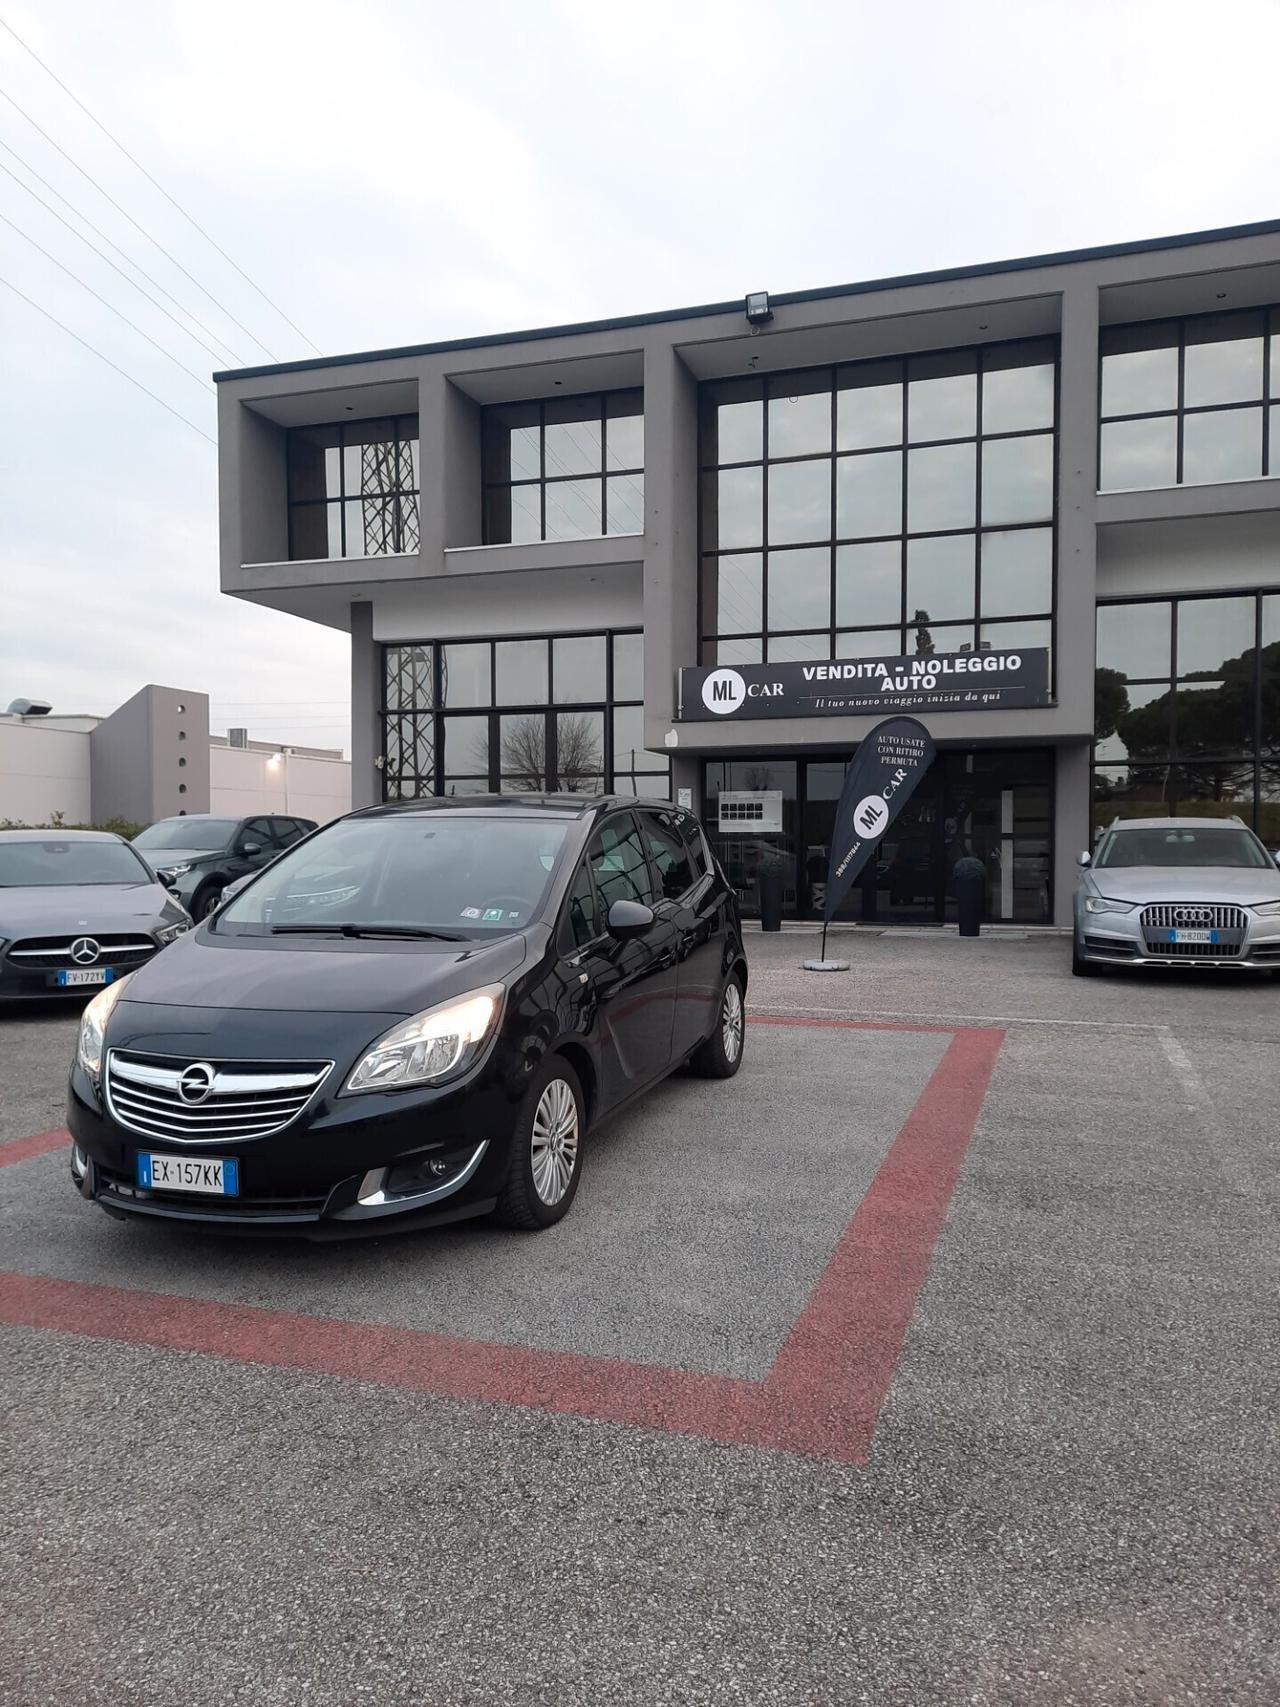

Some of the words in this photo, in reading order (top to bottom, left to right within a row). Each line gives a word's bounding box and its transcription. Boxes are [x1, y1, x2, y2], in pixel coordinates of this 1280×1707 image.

[802, 663, 888, 681] VENDITA
[912, 655, 1022, 675] NOLEGGIO
[713, 680, 737, 701] ML
[747, 683, 784, 697] CAR
[881, 675, 936, 692] AUTO
[815, 699, 825, 708] Il
[827, 700, 845, 708] tuo
[848, 699, 880, 707] nuovo
[884, 694, 924, 707] viaggio
[927, 693, 961, 703] inizia
[964, 691, 978, 701] da
[982, 690, 1000, 703] qui
[878, 736, 899, 744] AUTO
[900, 737, 926, 748] USATE
[877, 745, 895, 754] CON
[895, 747, 924, 757] RITIRO
[880, 756, 918, 767] PERMUTA
[859, 805, 883, 830] ML
[882, 768, 907, 800] CAR
